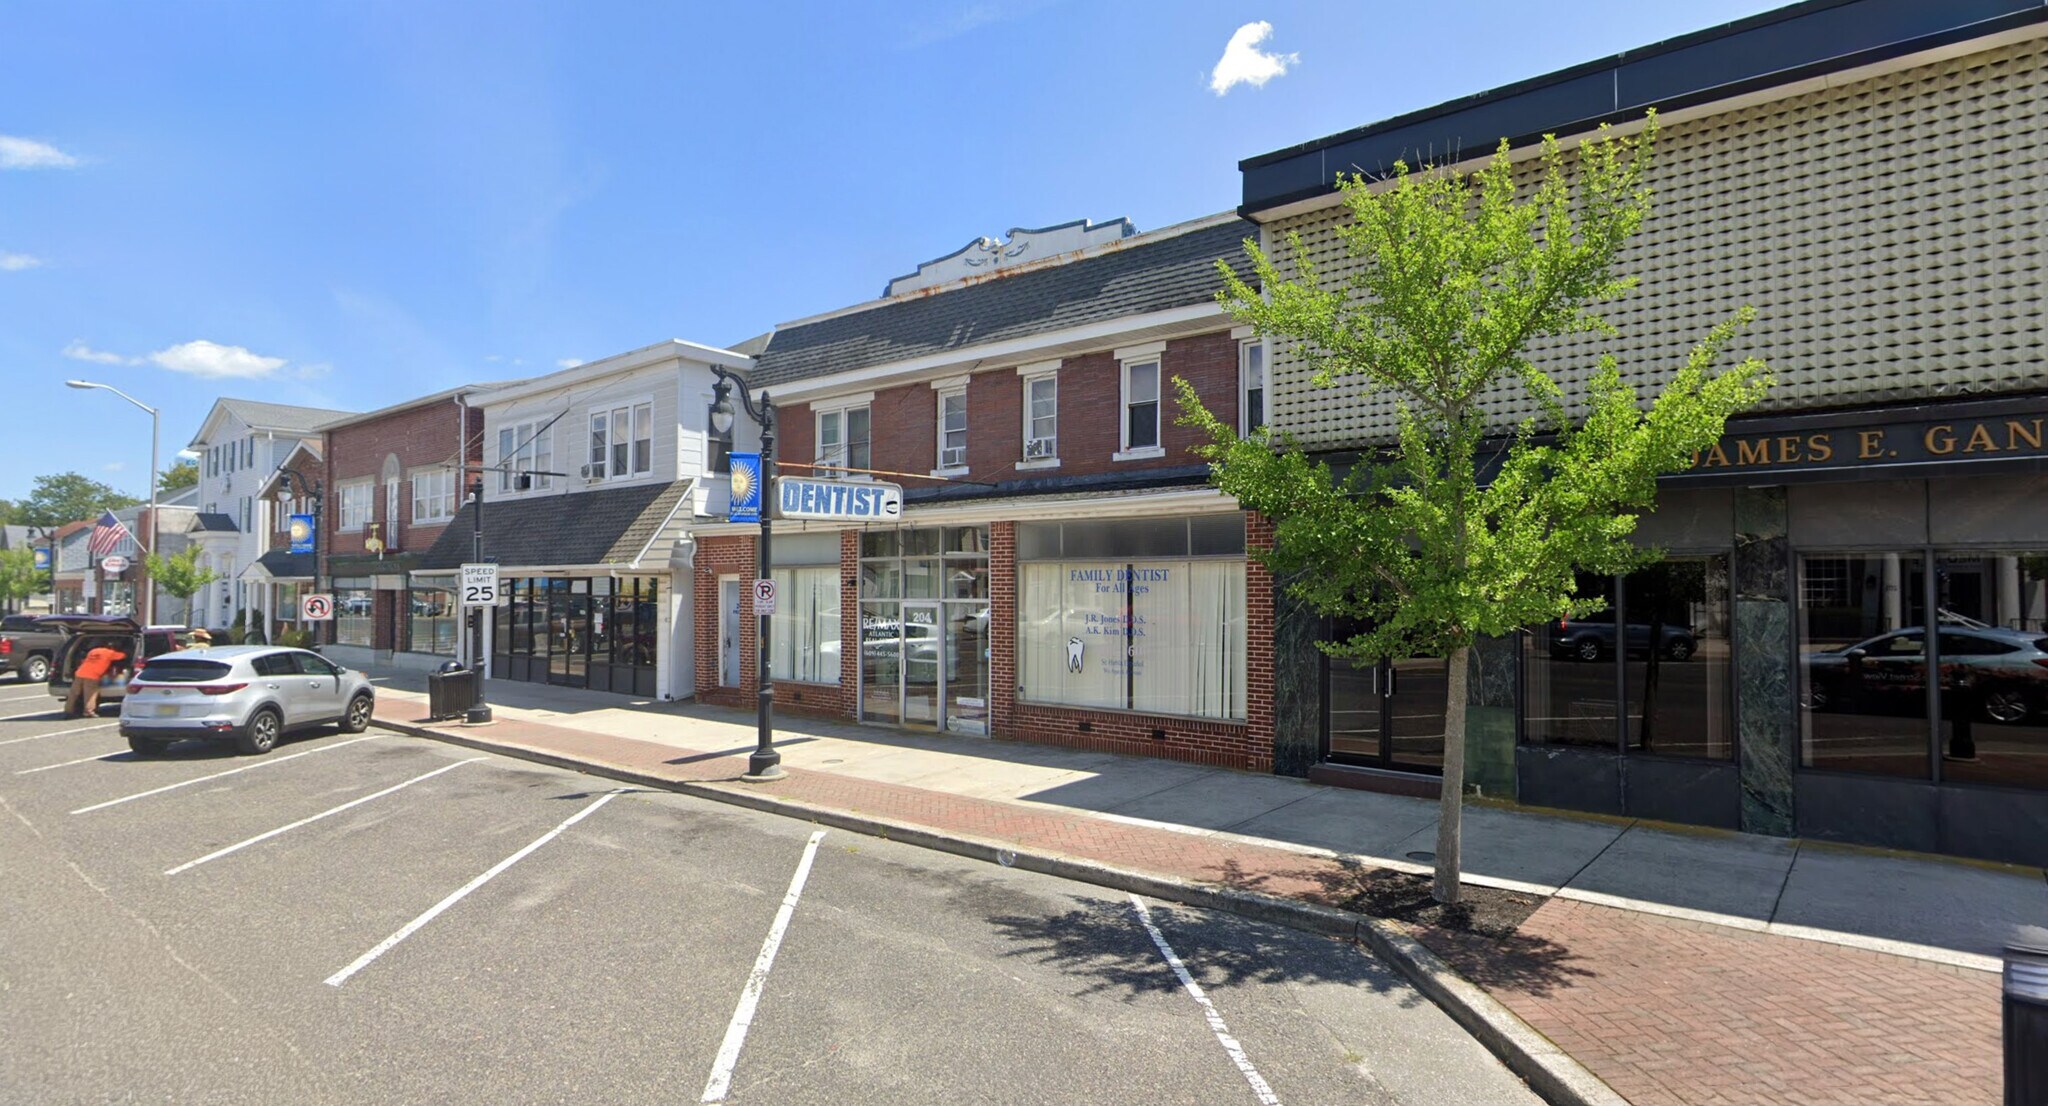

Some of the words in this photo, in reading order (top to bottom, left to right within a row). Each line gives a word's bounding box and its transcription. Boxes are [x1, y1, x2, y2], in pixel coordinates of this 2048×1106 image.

[1858, 430, 1898, 459] E.
[782, 482, 885, 516] DENTIST
[464, 567, 495, 575] SPEED
[1070, 569, 1113, 581] FAMILY
[1117, 569, 1170, 581] DENTIST
[467, 576, 491, 584] LIMIT
[1096, 583, 1110, 593] For
[1112, 582, 1125, 593] All
[466, 586, 494, 601] 25
[912, 612, 932, 623] 204
[1100, 614, 1120, 625] Jones
[863, 617, 900, 630] RE/MAX
[1103, 626, 1120, 636] Kim
